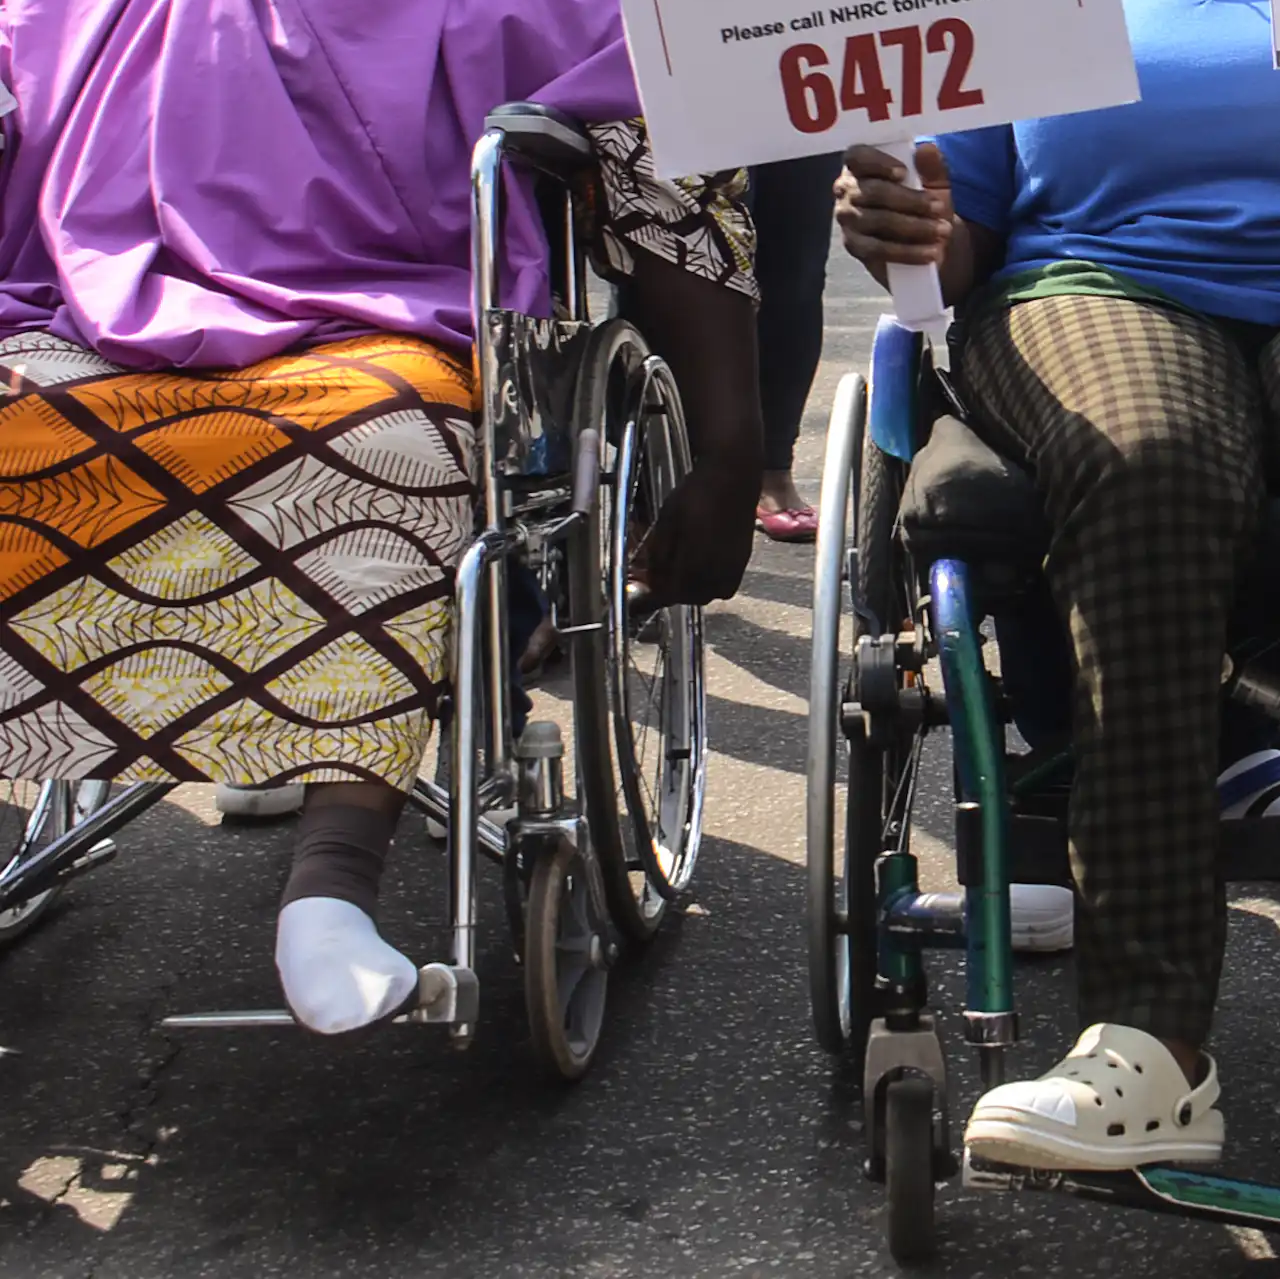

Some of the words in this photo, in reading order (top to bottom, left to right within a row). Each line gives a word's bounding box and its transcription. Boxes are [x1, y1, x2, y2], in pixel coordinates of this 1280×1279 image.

[720, 20, 786, 44] Please
[790, 10, 826, 32] call
[830, 0, 888, 26] NHRC
[777, 17, 984, 135] 6472
